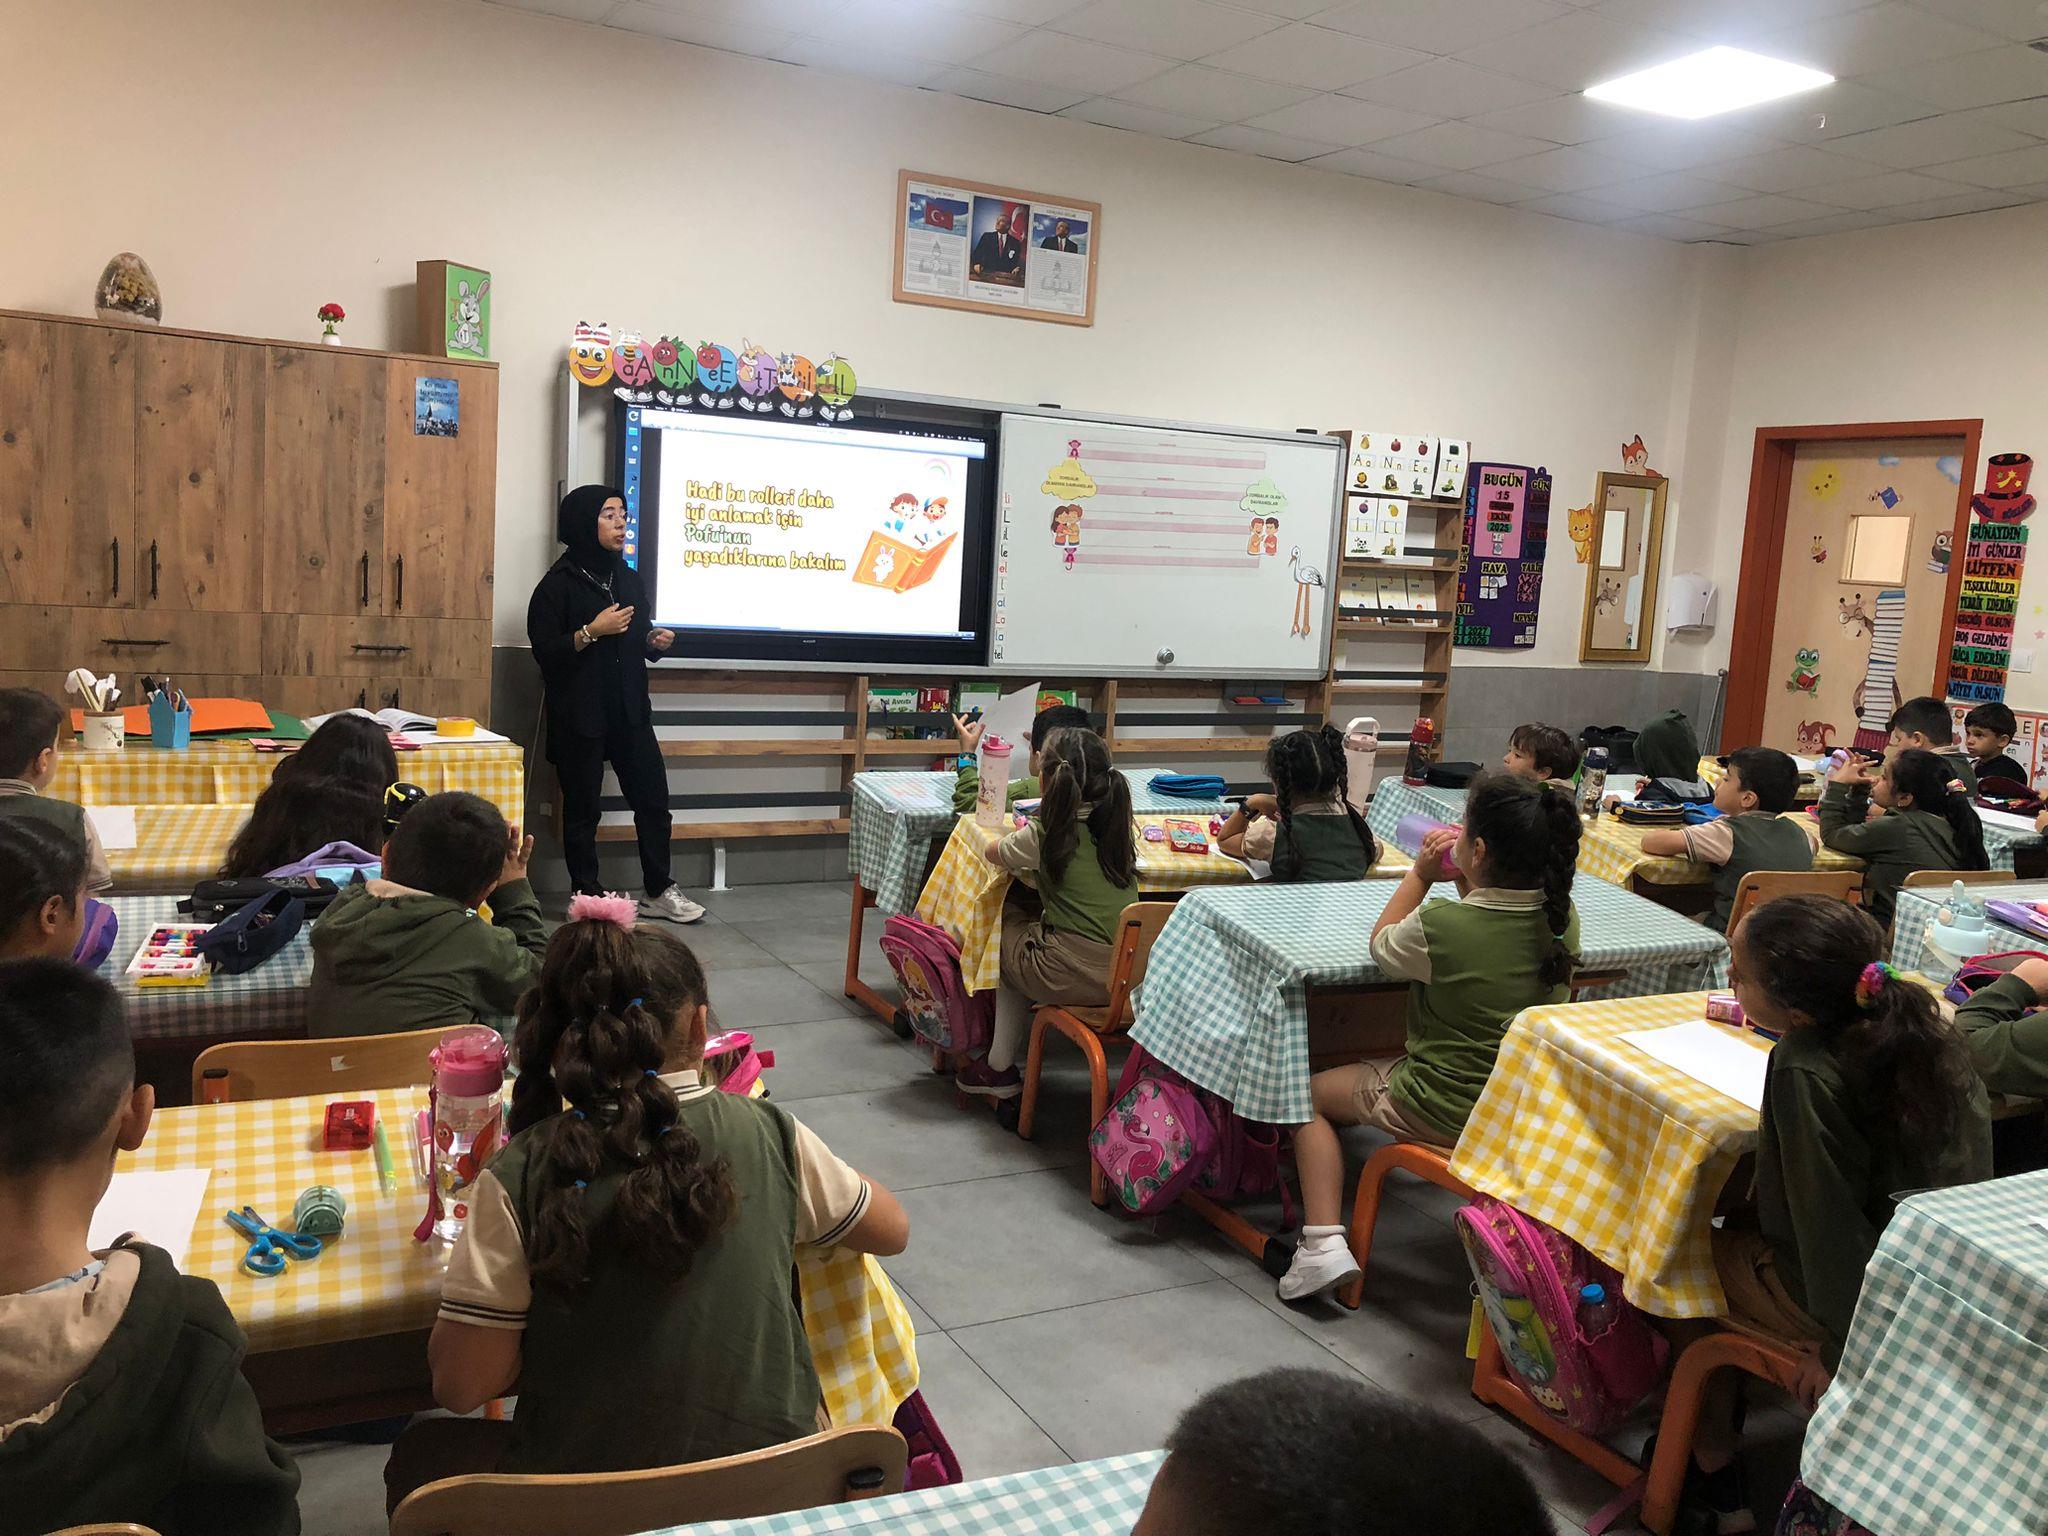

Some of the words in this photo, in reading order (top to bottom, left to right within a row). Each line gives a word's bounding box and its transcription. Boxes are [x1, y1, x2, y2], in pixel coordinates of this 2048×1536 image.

[623, 356, 653, 380] aA
[662, 358, 694, 381] nN
[708, 360, 732, 384] eE
[755, 367, 777, 391] tT
[1483, 472, 1523, 487] BUGÜN
[1531, 478, 1550, 491] GÜN
[686, 480, 723, 501] Hadi
[726, 483, 745, 502] bu
[749, 486, 795, 506] rolleri
[798, 488, 834, 509] daha
[1497, 491, 1510, 500] 15
[685, 503, 705, 525] iyi
[709, 504, 773, 525] anlamak
[776, 509, 802, 531] için
[1490, 512, 1511, 522] EKİM
[1489, 522, 1510, 532] 2025
[1971, 524, 2021, 540] GÜNAYDIN
[1968, 542, 1980, 557] İYİ
[1986, 543, 2022, 559] GÜNLER
[684, 546, 786, 568] yaşadıklarına
[790, 550, 846, 571] bakalım
[1482, 562, 1507, 574] HAVA
[1966, 558, 2017, 577] LÜTFEN
[1964, 580, 2015, 594] TEŞEKKÜRLER
[1457, 604, 1474, 614] YIL
[1986, 597, 2014, 612] EDERİM
[1985, 615, 2012, 628] OLSUN
[1971, 632, 2008, 647] GELDİNİZ
[1974, 650, 2007, 666] EDERİM
[1971, 667, 2003, 684] DİLERİM
[1974, 684, 2002, 700] OLSUN
[2023, 721, 2032, 734] E
